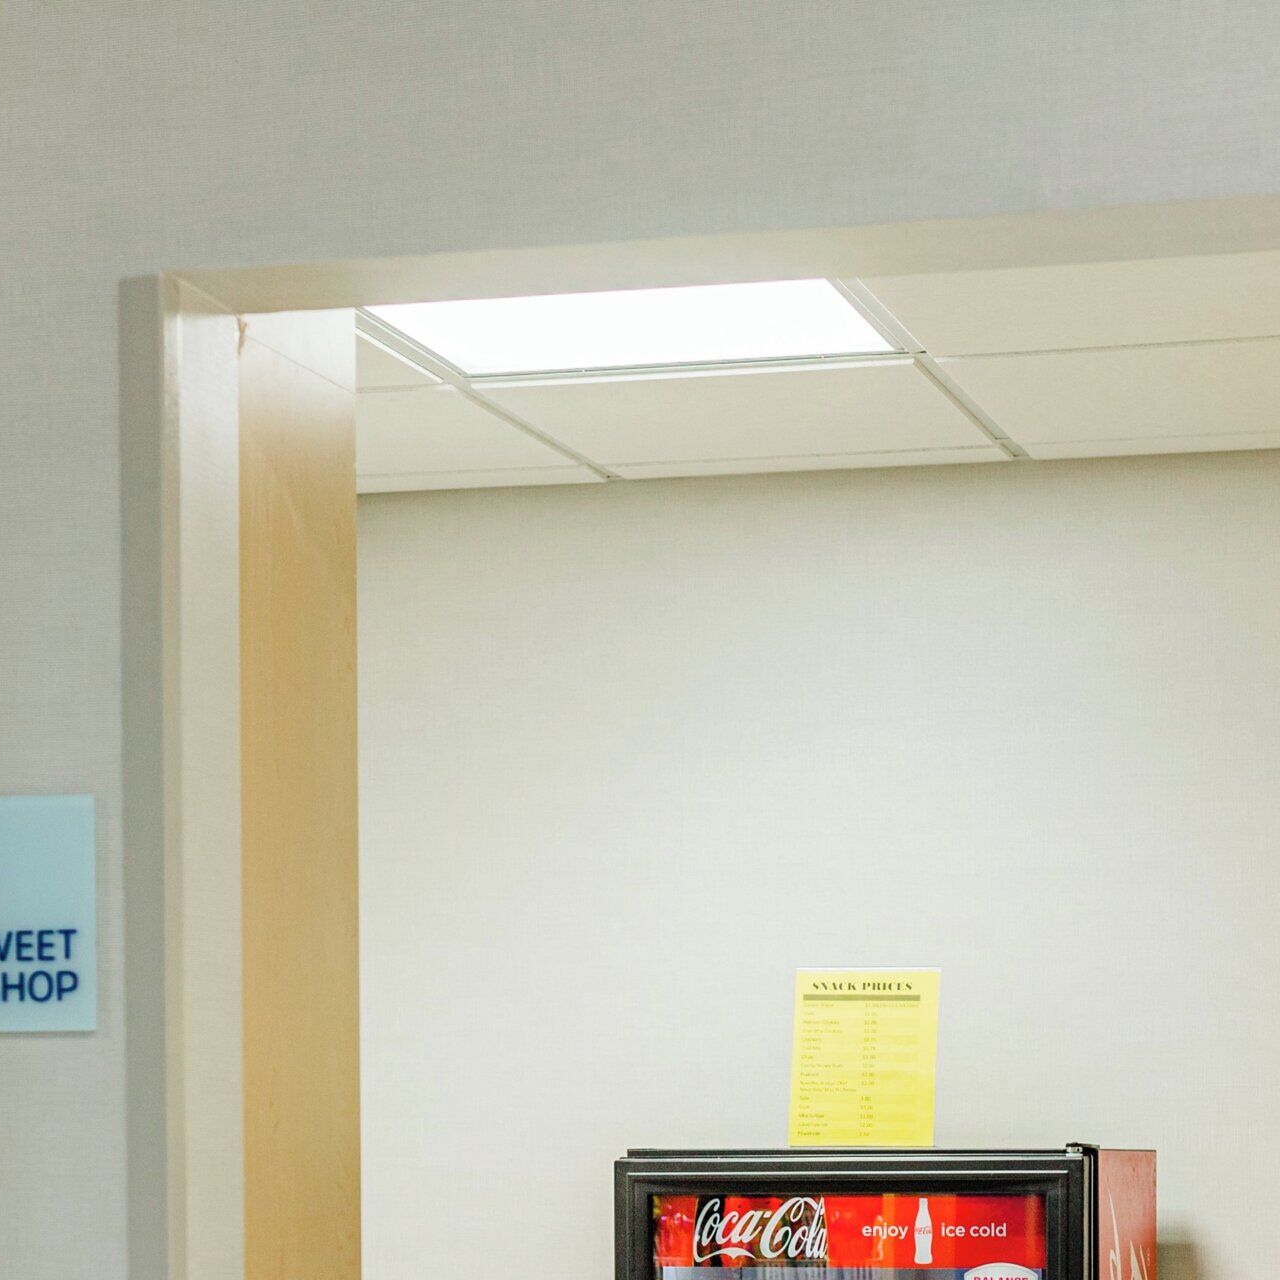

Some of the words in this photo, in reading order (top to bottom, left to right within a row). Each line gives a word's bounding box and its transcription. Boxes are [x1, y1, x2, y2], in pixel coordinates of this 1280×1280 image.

[812, 981, 857, 991] SNACK
[862, 981, 913, 991] PRICES
[693, 1196, 828, 1263] Coca-Cola
[862, 1222, 910, 1239] enjoy
[940, 1222, 966, 1237] ice
[969, 1222, 1007, 1237] cold
